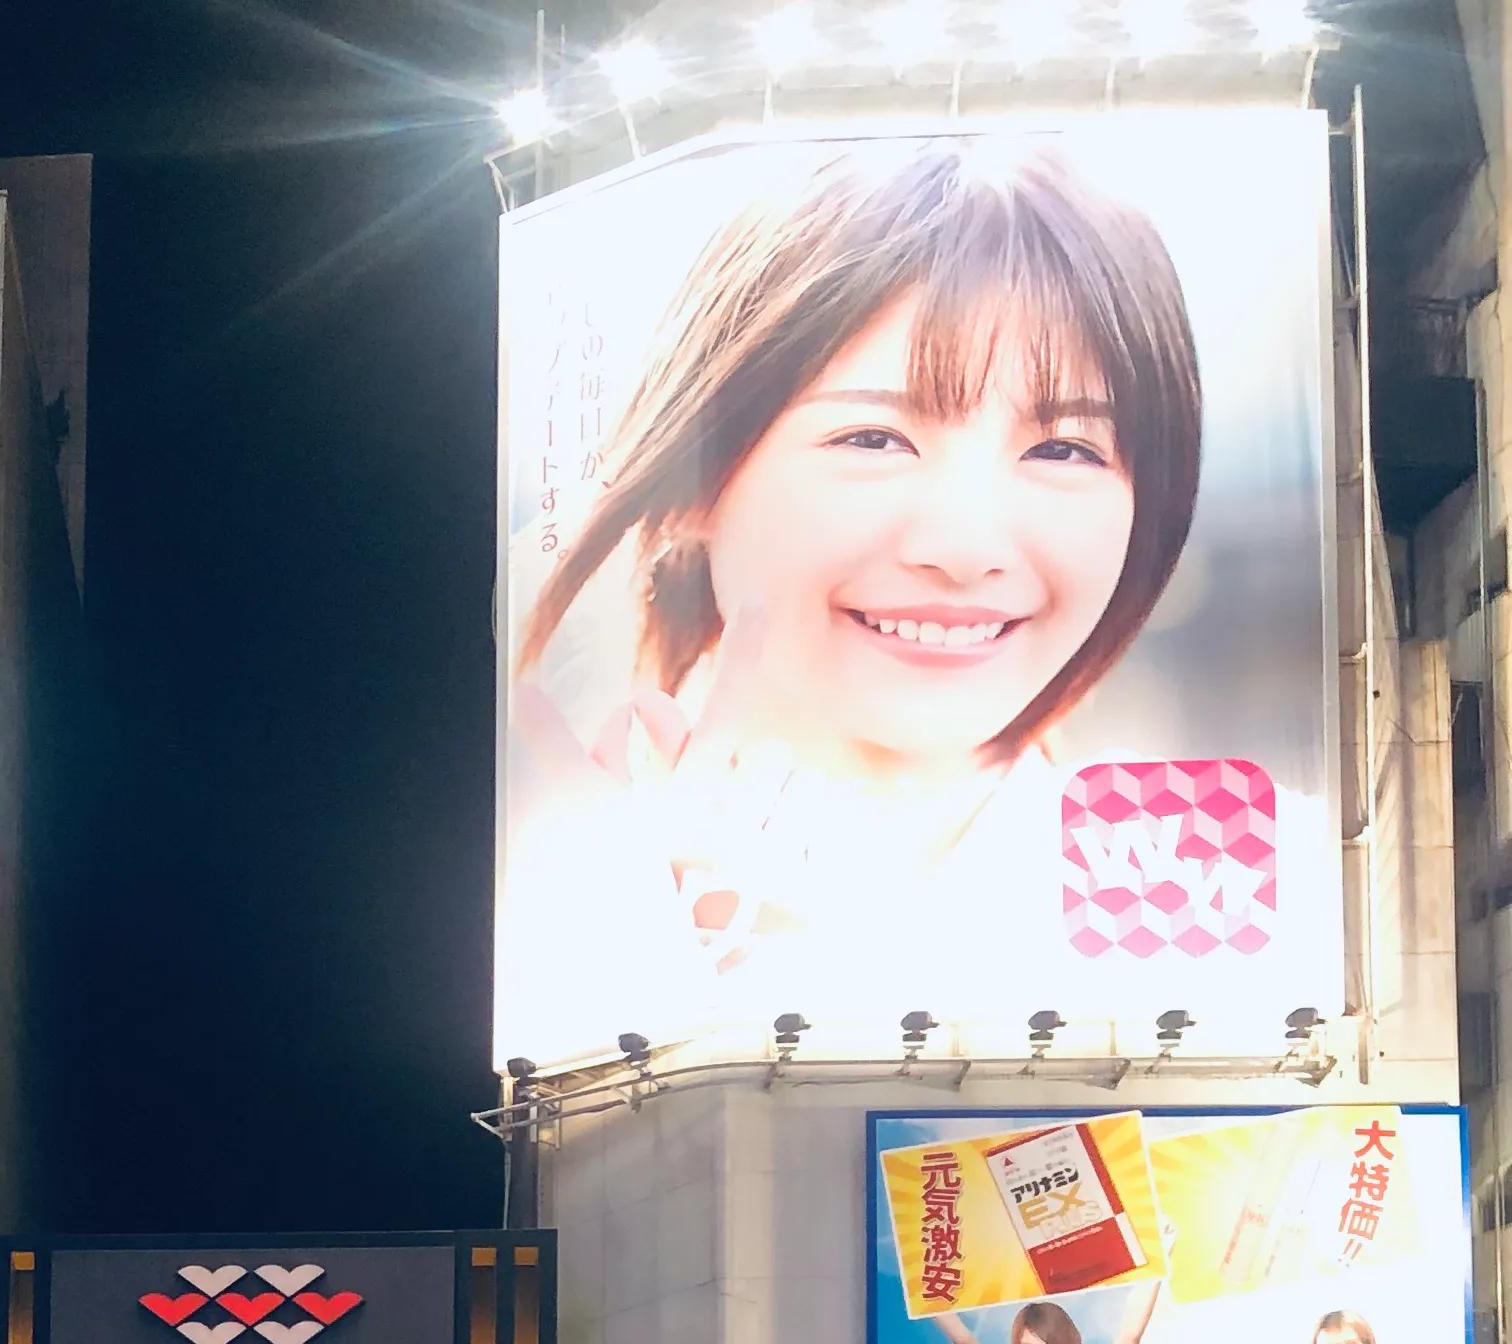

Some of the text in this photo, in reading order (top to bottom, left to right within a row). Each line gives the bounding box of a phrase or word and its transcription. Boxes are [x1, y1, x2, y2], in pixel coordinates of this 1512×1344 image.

[1009, 1167, 1080, 1205] アリナミン
[1017, 1181, 1087, 1230] EX
[921, 1152, 963, 1303] 元気激安
